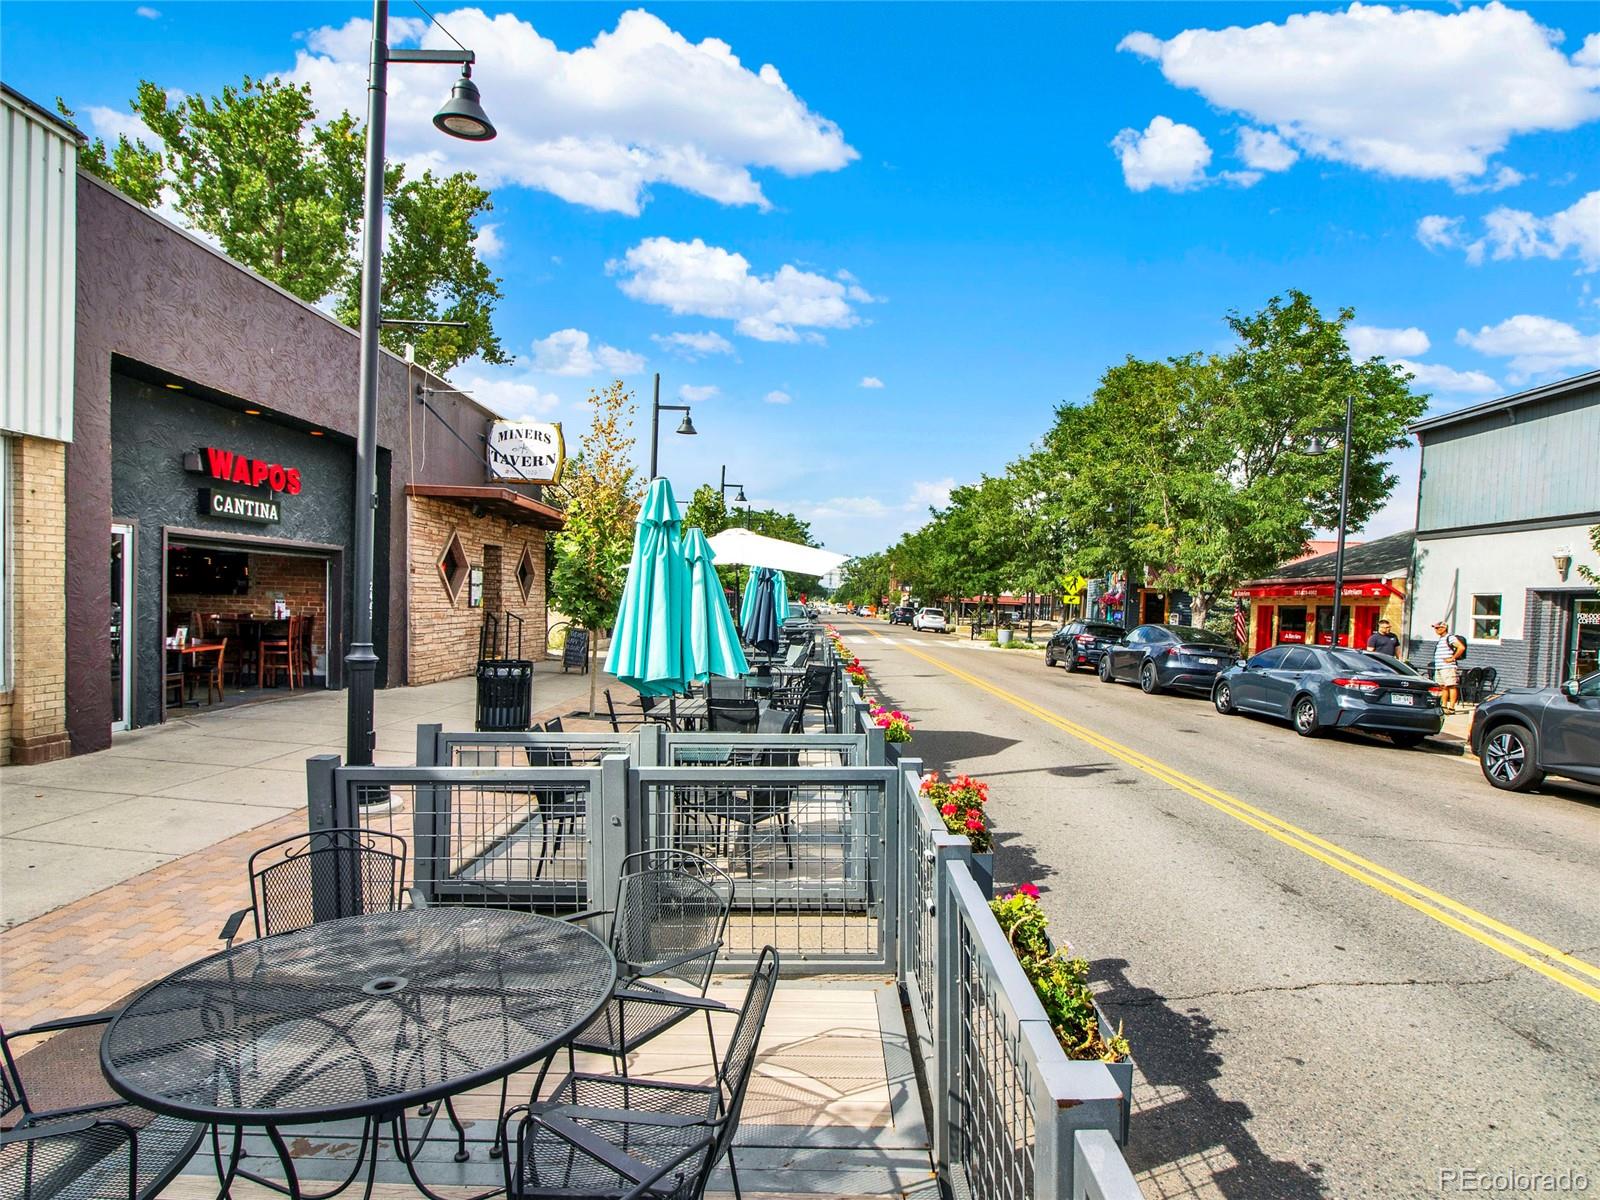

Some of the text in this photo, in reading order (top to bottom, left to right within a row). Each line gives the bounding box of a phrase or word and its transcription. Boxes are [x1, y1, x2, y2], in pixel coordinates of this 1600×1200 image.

[498, 429, 551, 444] MINERS
[491, 450, 556, 468] TAVERN
[208, 447, 302, 496] WAPOS
[213, 494, 279, 521] CANTINA
